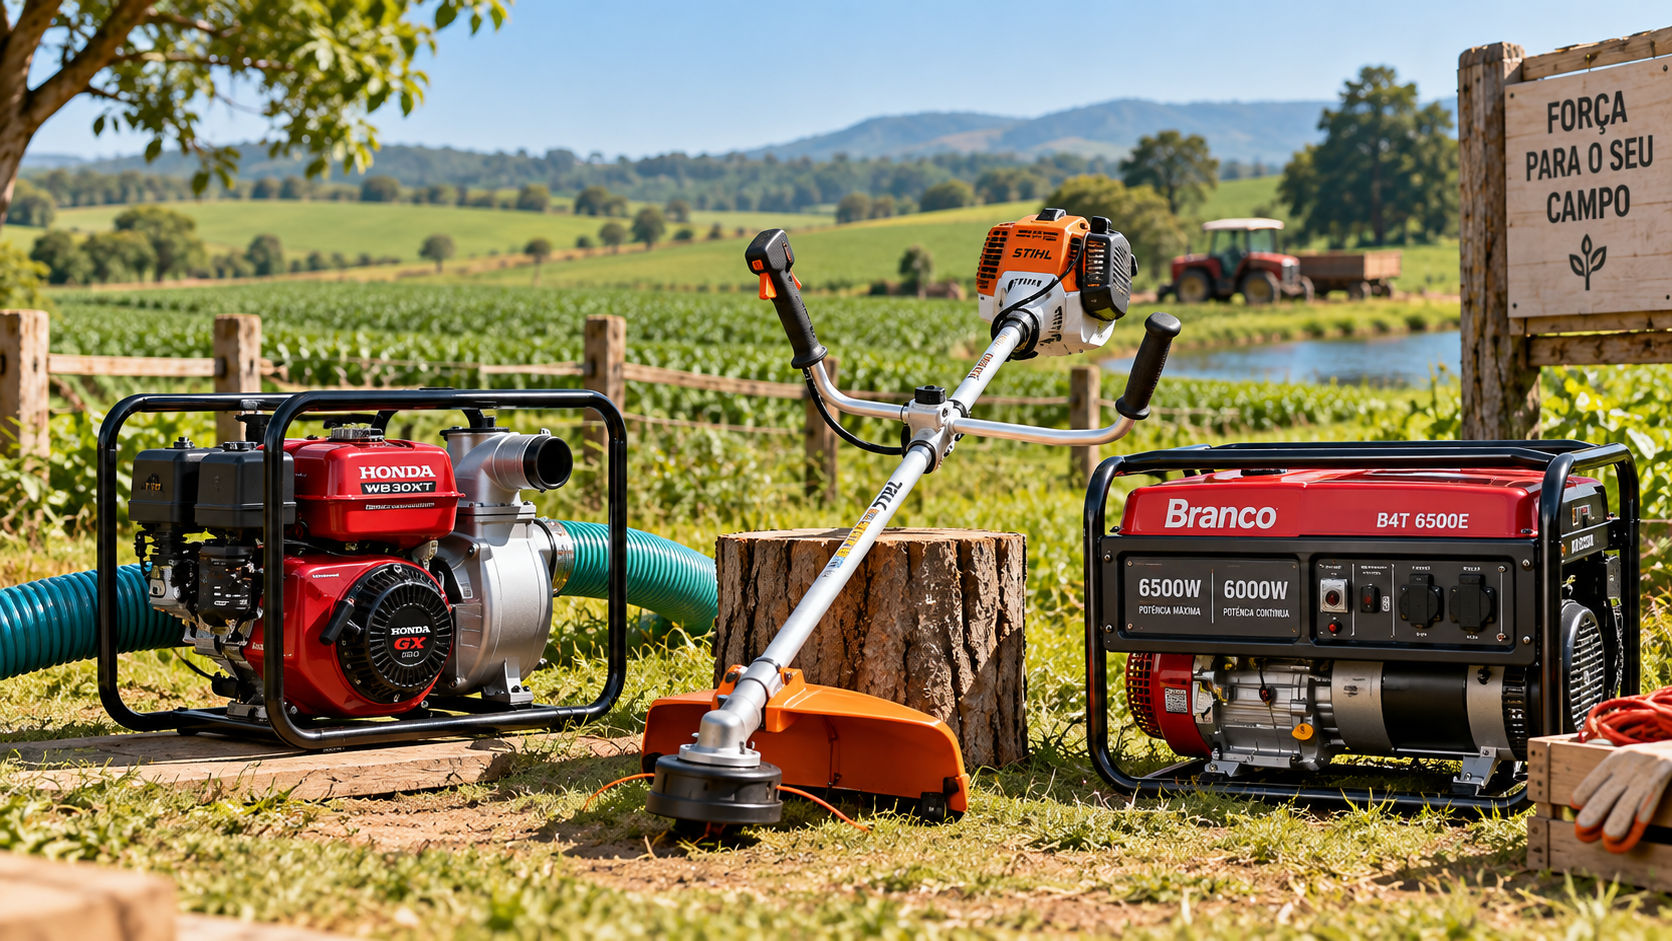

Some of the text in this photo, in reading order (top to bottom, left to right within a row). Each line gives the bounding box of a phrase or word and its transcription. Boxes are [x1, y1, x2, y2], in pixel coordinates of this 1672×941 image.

[1547, 90, 1628, 135] FORÇA
[1526, 135, 1653, 181] PARA O SEU
[1546, 184, 1630, 223] CAMPO
[1012, 248, 1052, 260] STIHL
[358, 465, 436, 479] HONDA
[1164, 498, 1277, 529] Branco
[1376, 512, 1469, 529] B4T 6500E
[1139, 578, 1201, 598] 6500W
[1224, 579, 1288, 600] 6000W
[390, 625, 431, 636] HONDA
[394, 636, 427, 650] GX
